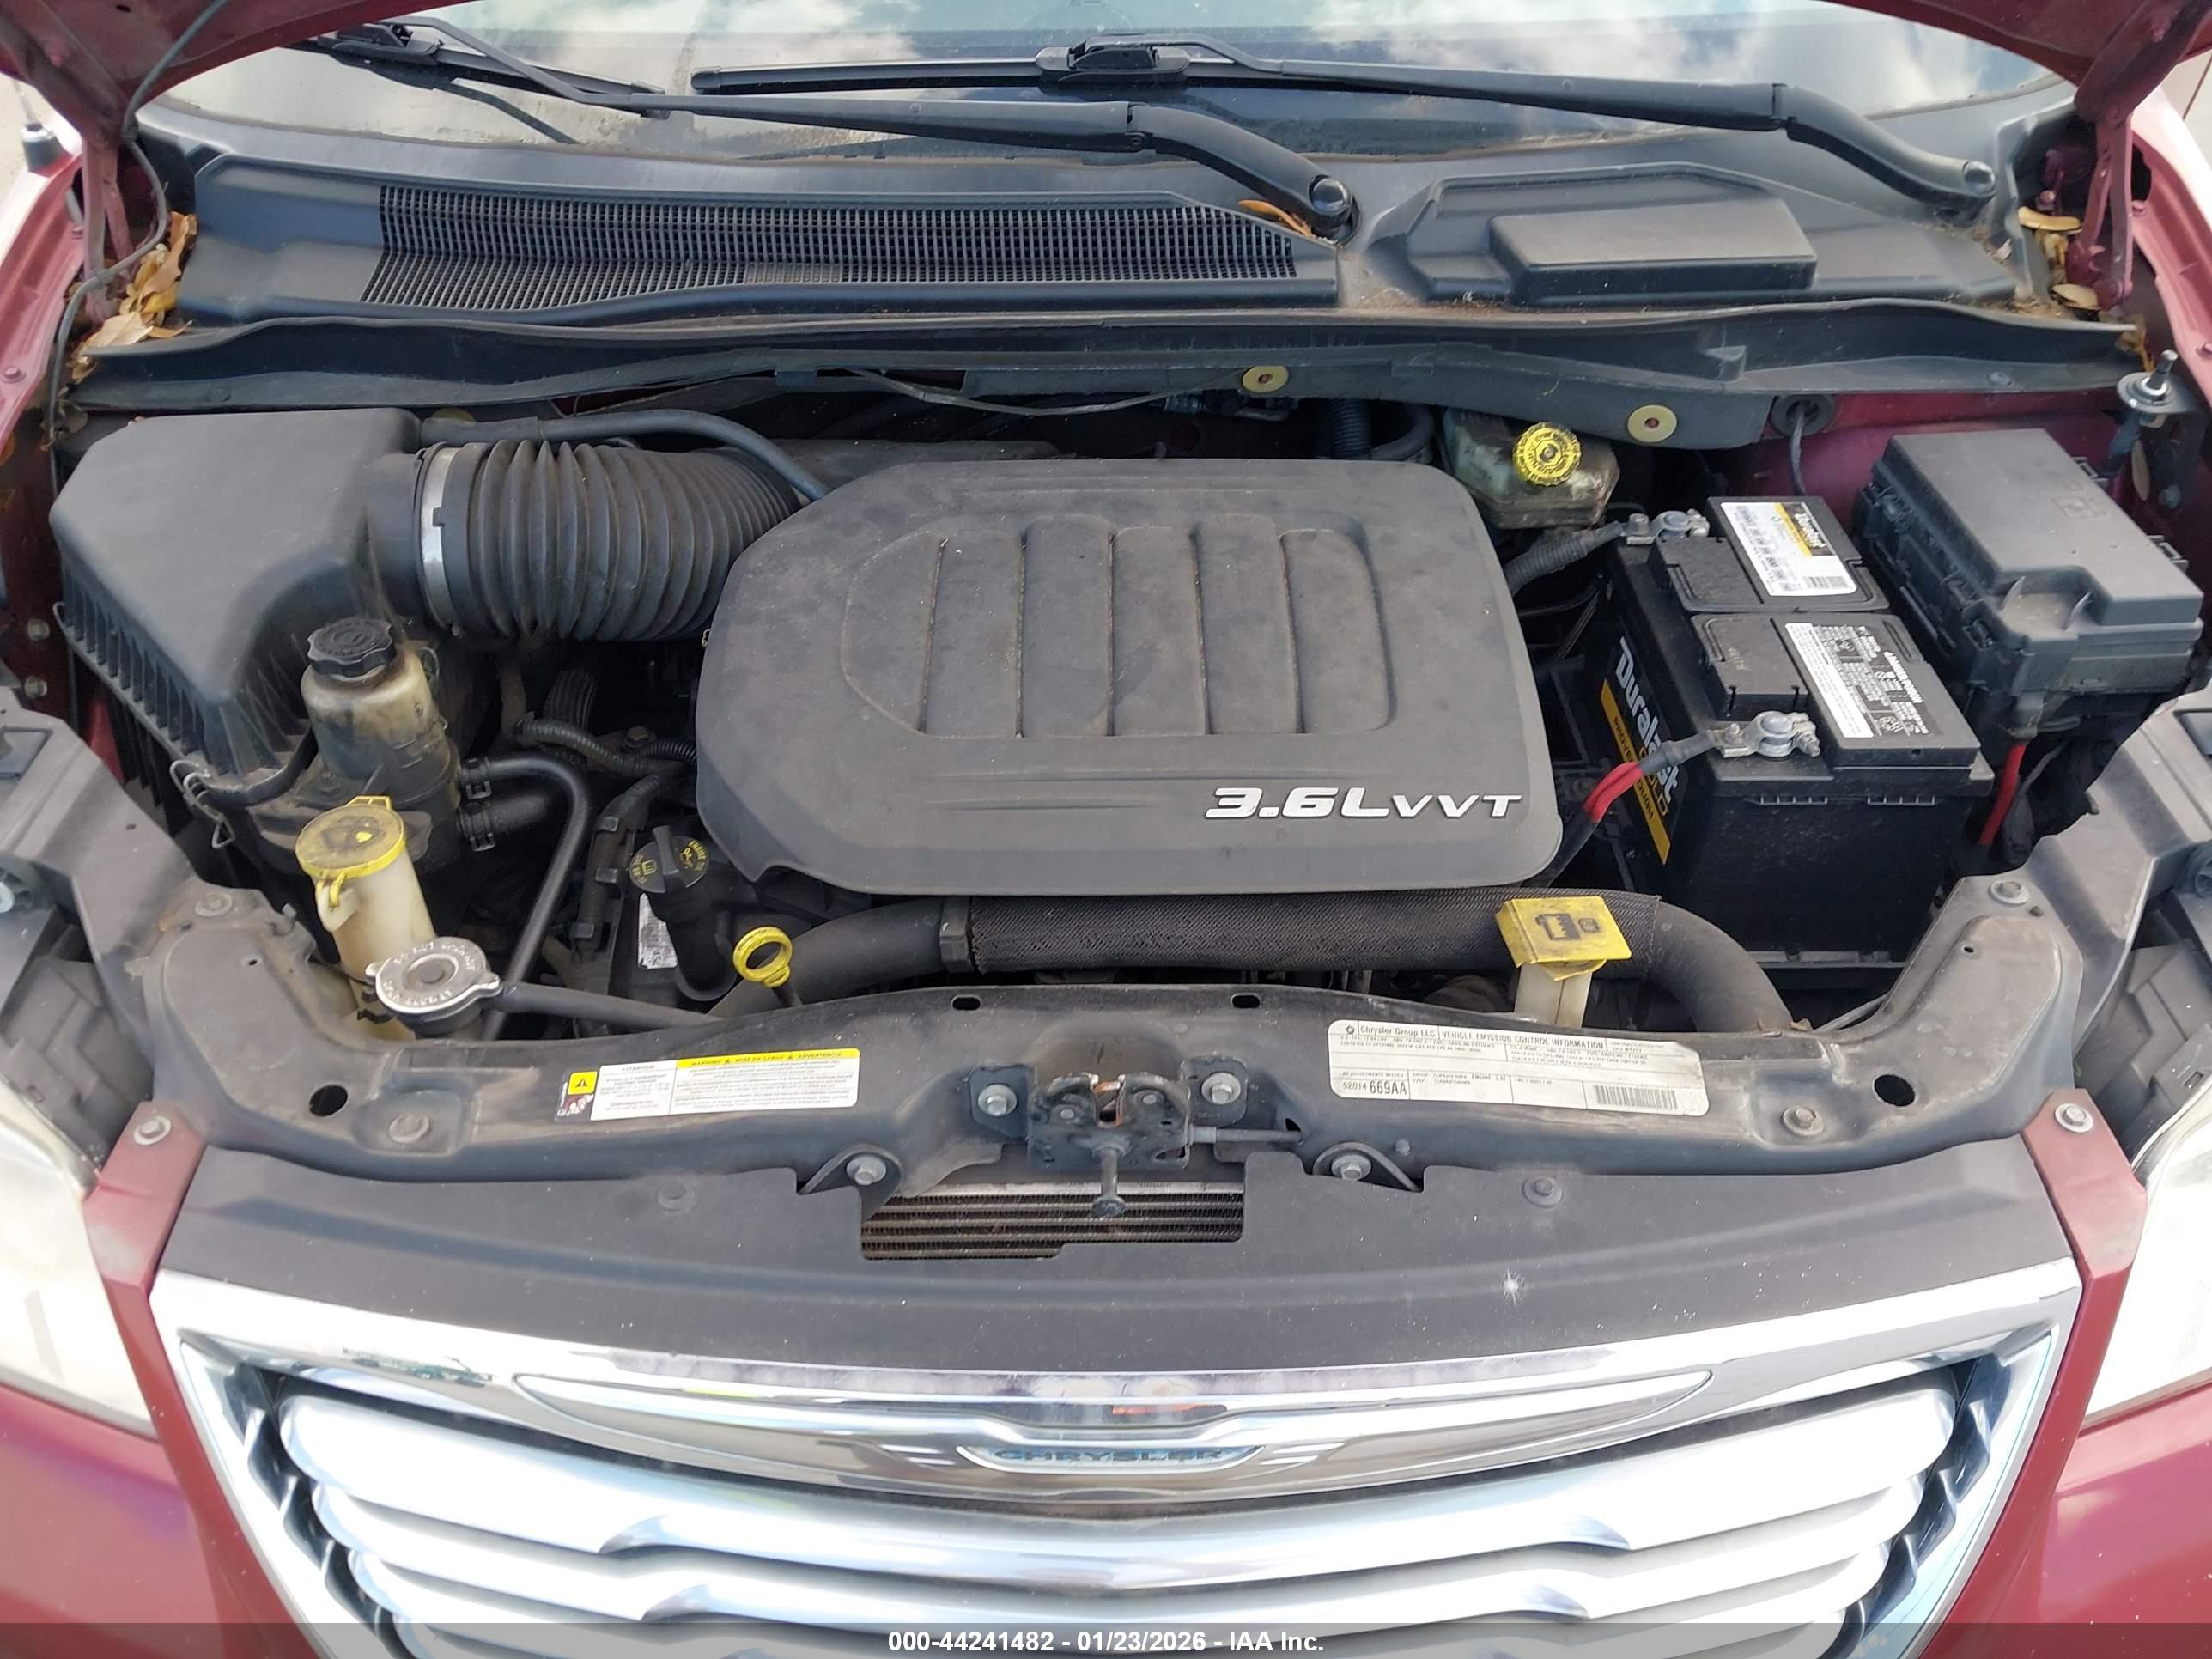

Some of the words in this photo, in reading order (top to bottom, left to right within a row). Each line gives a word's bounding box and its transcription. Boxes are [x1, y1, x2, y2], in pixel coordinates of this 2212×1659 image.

[1360, 1024, 1392, 1037] Chrysler
[1395, 1027, 1419, 1037] Group
[1420, 1030, 1436, 1038] LLC
[1442, 1030, 1472, 1039] VEHICLE
[1475, 1033, 1512, 1042] EMISSION
[1514, 1035, 1547, 1045] CONTROL
[1552, 1037, 1605, 1049] INFORMATION
[1369, 1079, 1407, 1095] 669AA
